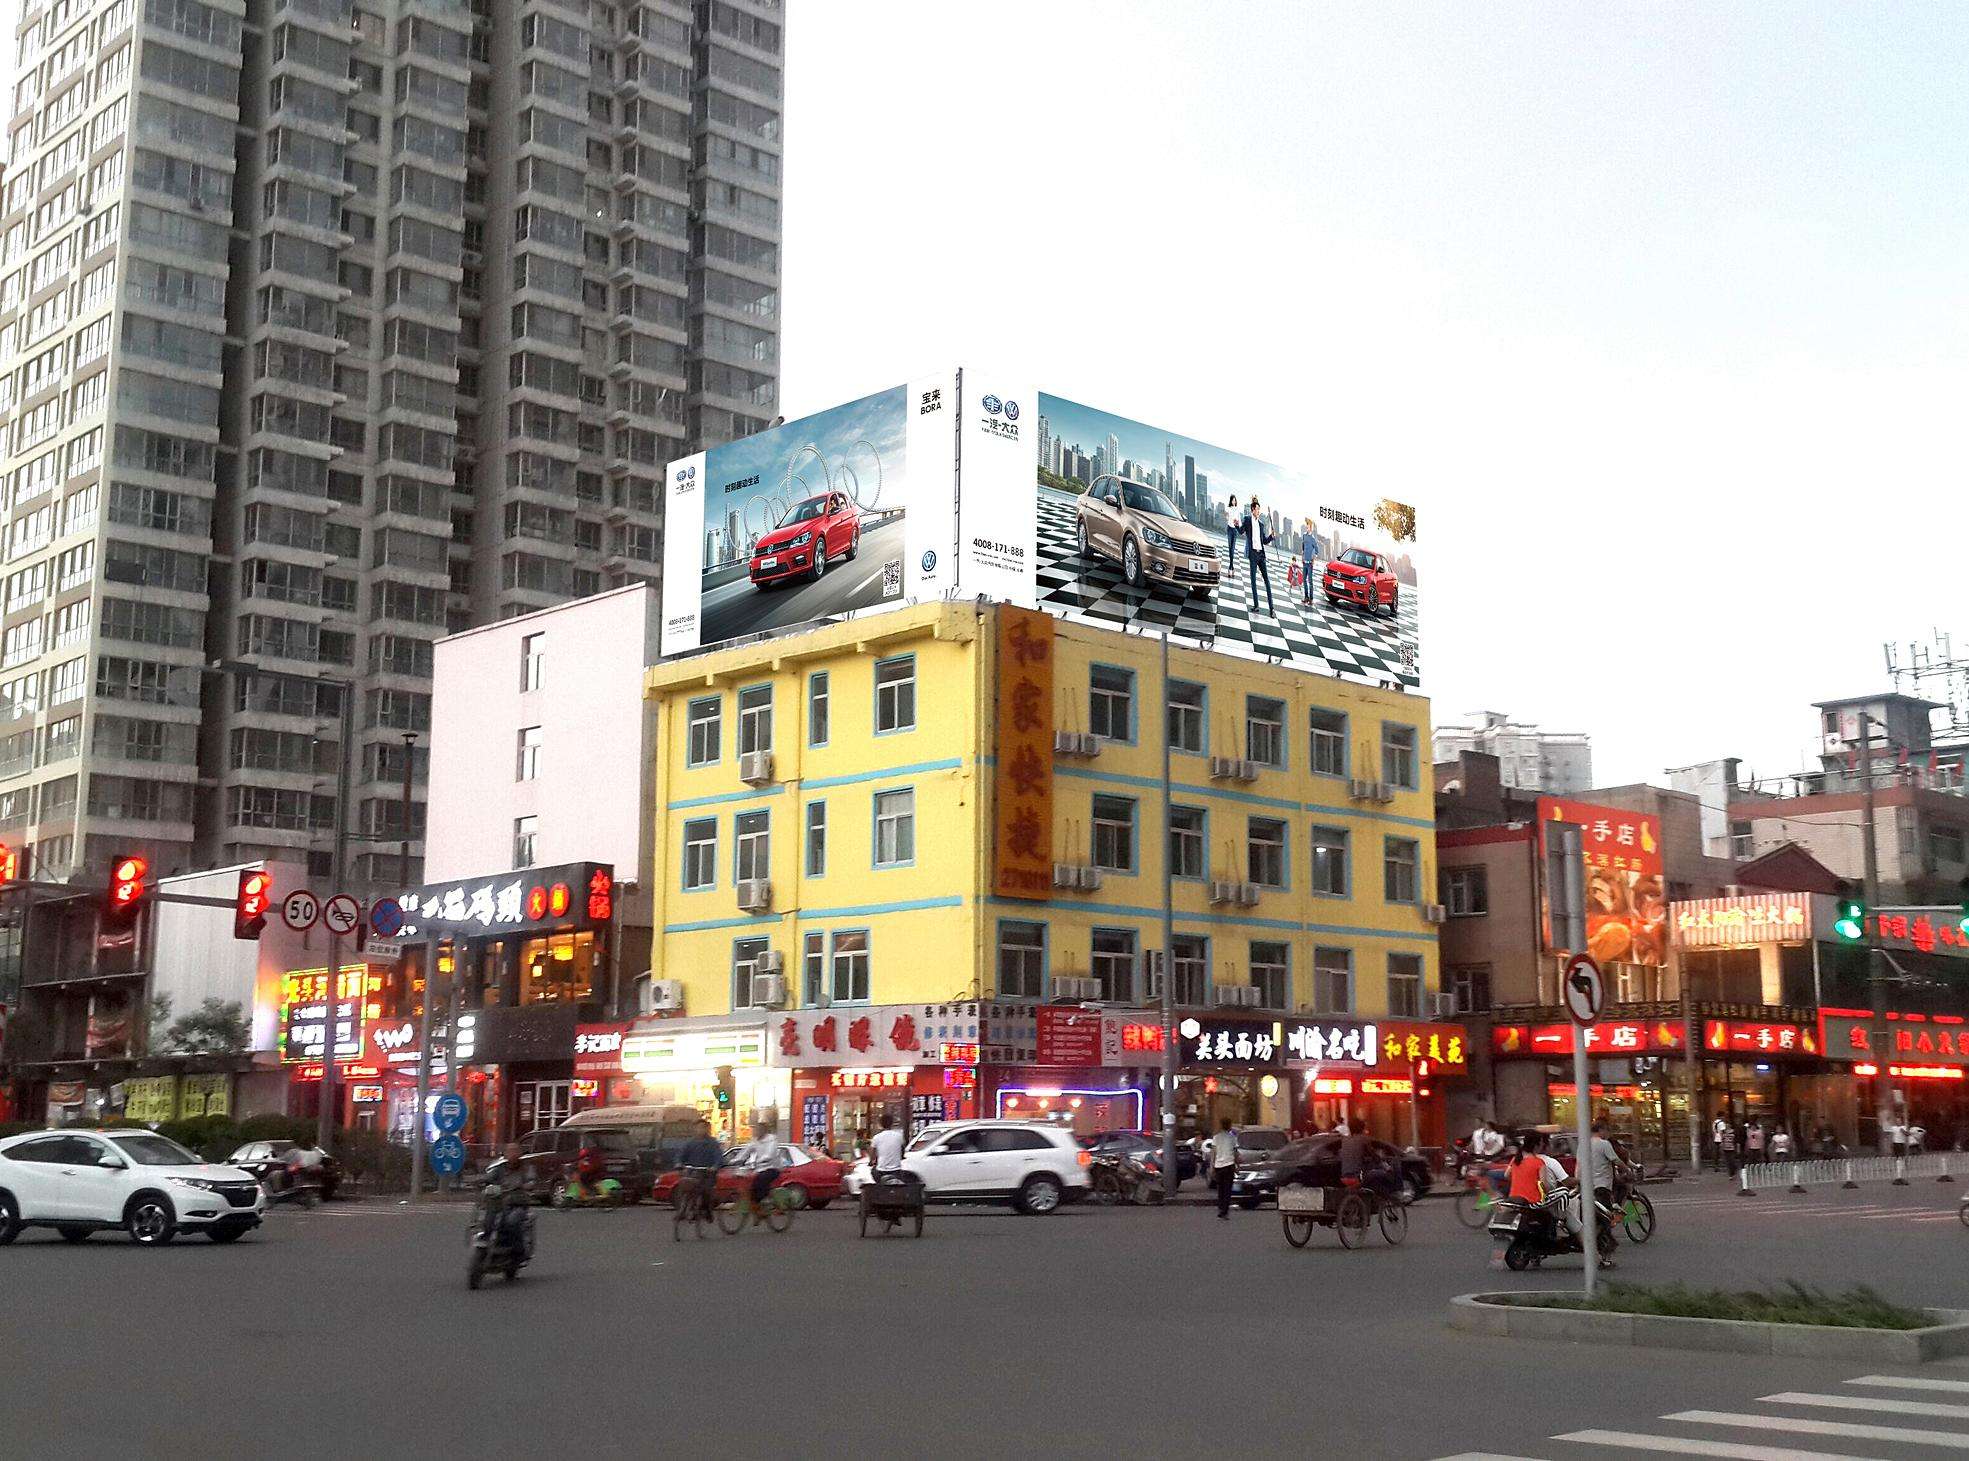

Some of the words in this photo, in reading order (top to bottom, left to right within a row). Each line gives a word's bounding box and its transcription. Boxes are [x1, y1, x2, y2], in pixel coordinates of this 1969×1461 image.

[921, 388, 941, 405] 宝来
[920, 402, 941, 415] BORA
[1581, 819, 1635, 846] 手店
[289, 900, 313, 920] 50
[1733, 1028, 1794, 1049] 一手店
